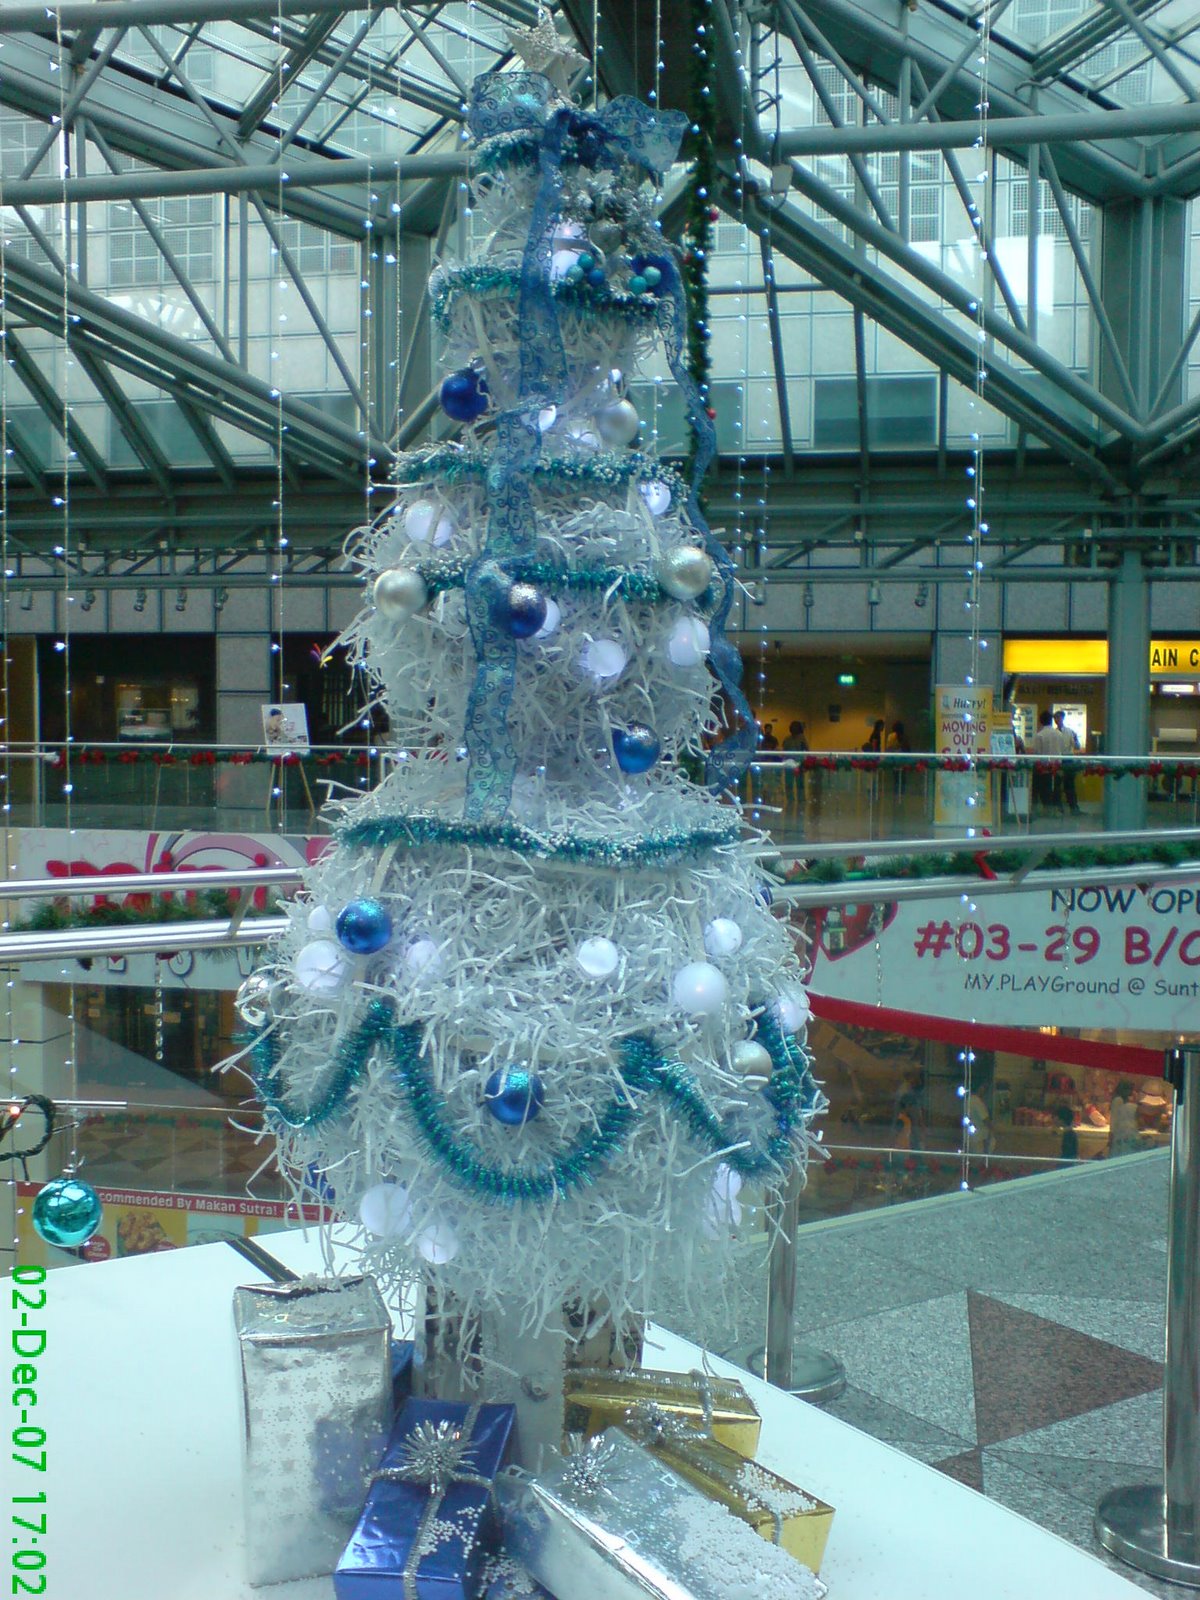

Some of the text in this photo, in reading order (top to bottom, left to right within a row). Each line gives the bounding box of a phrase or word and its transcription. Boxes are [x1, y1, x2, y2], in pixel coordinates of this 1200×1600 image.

[953, 697, 986, 710] Hurry!
[942, 720, 987, 733] MOVING
[953, 733, 974, 746] OUT
[1051, 887, 1200, 914] NOW OP
[914, 920, 1100, 965] #03-29
[964, 973, 1120, 994] MY.PLAYGround
[1127, 977, 1146, 995] @
[176, 1197, 192, 1211] By
[195, 1199, 237, 1214] Makan
[239, 1202, 278, 1216] Sutra!
